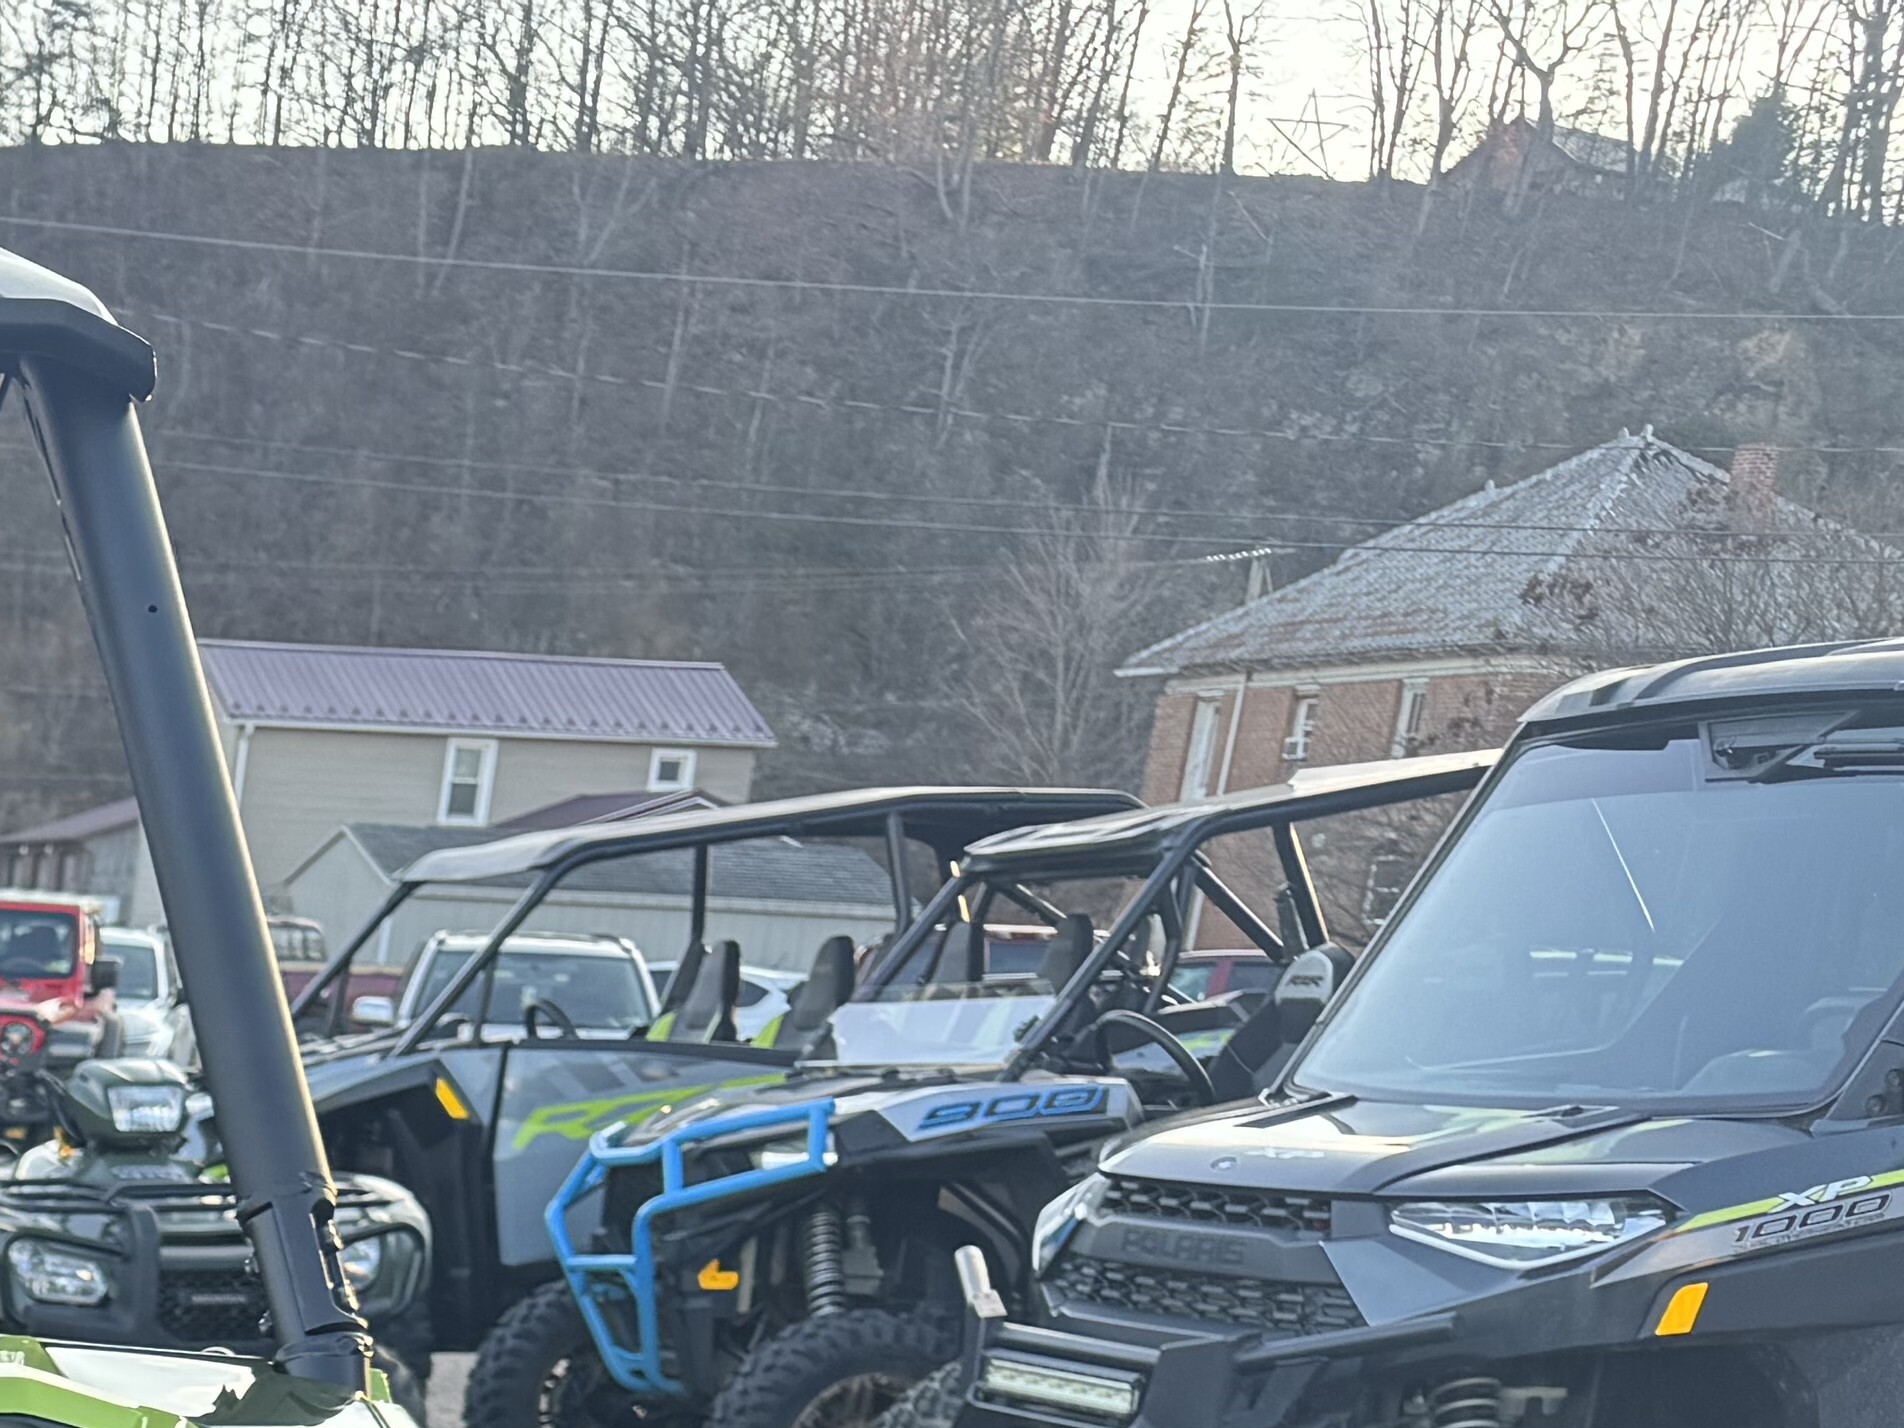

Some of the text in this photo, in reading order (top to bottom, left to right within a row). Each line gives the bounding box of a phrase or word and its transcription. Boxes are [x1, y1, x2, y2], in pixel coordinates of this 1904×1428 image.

[512, 1072, 788, 1151] RZ
[1735, 1193, 1893, 1243] 1000
[1767, 1175, 1873, 1214] XP
